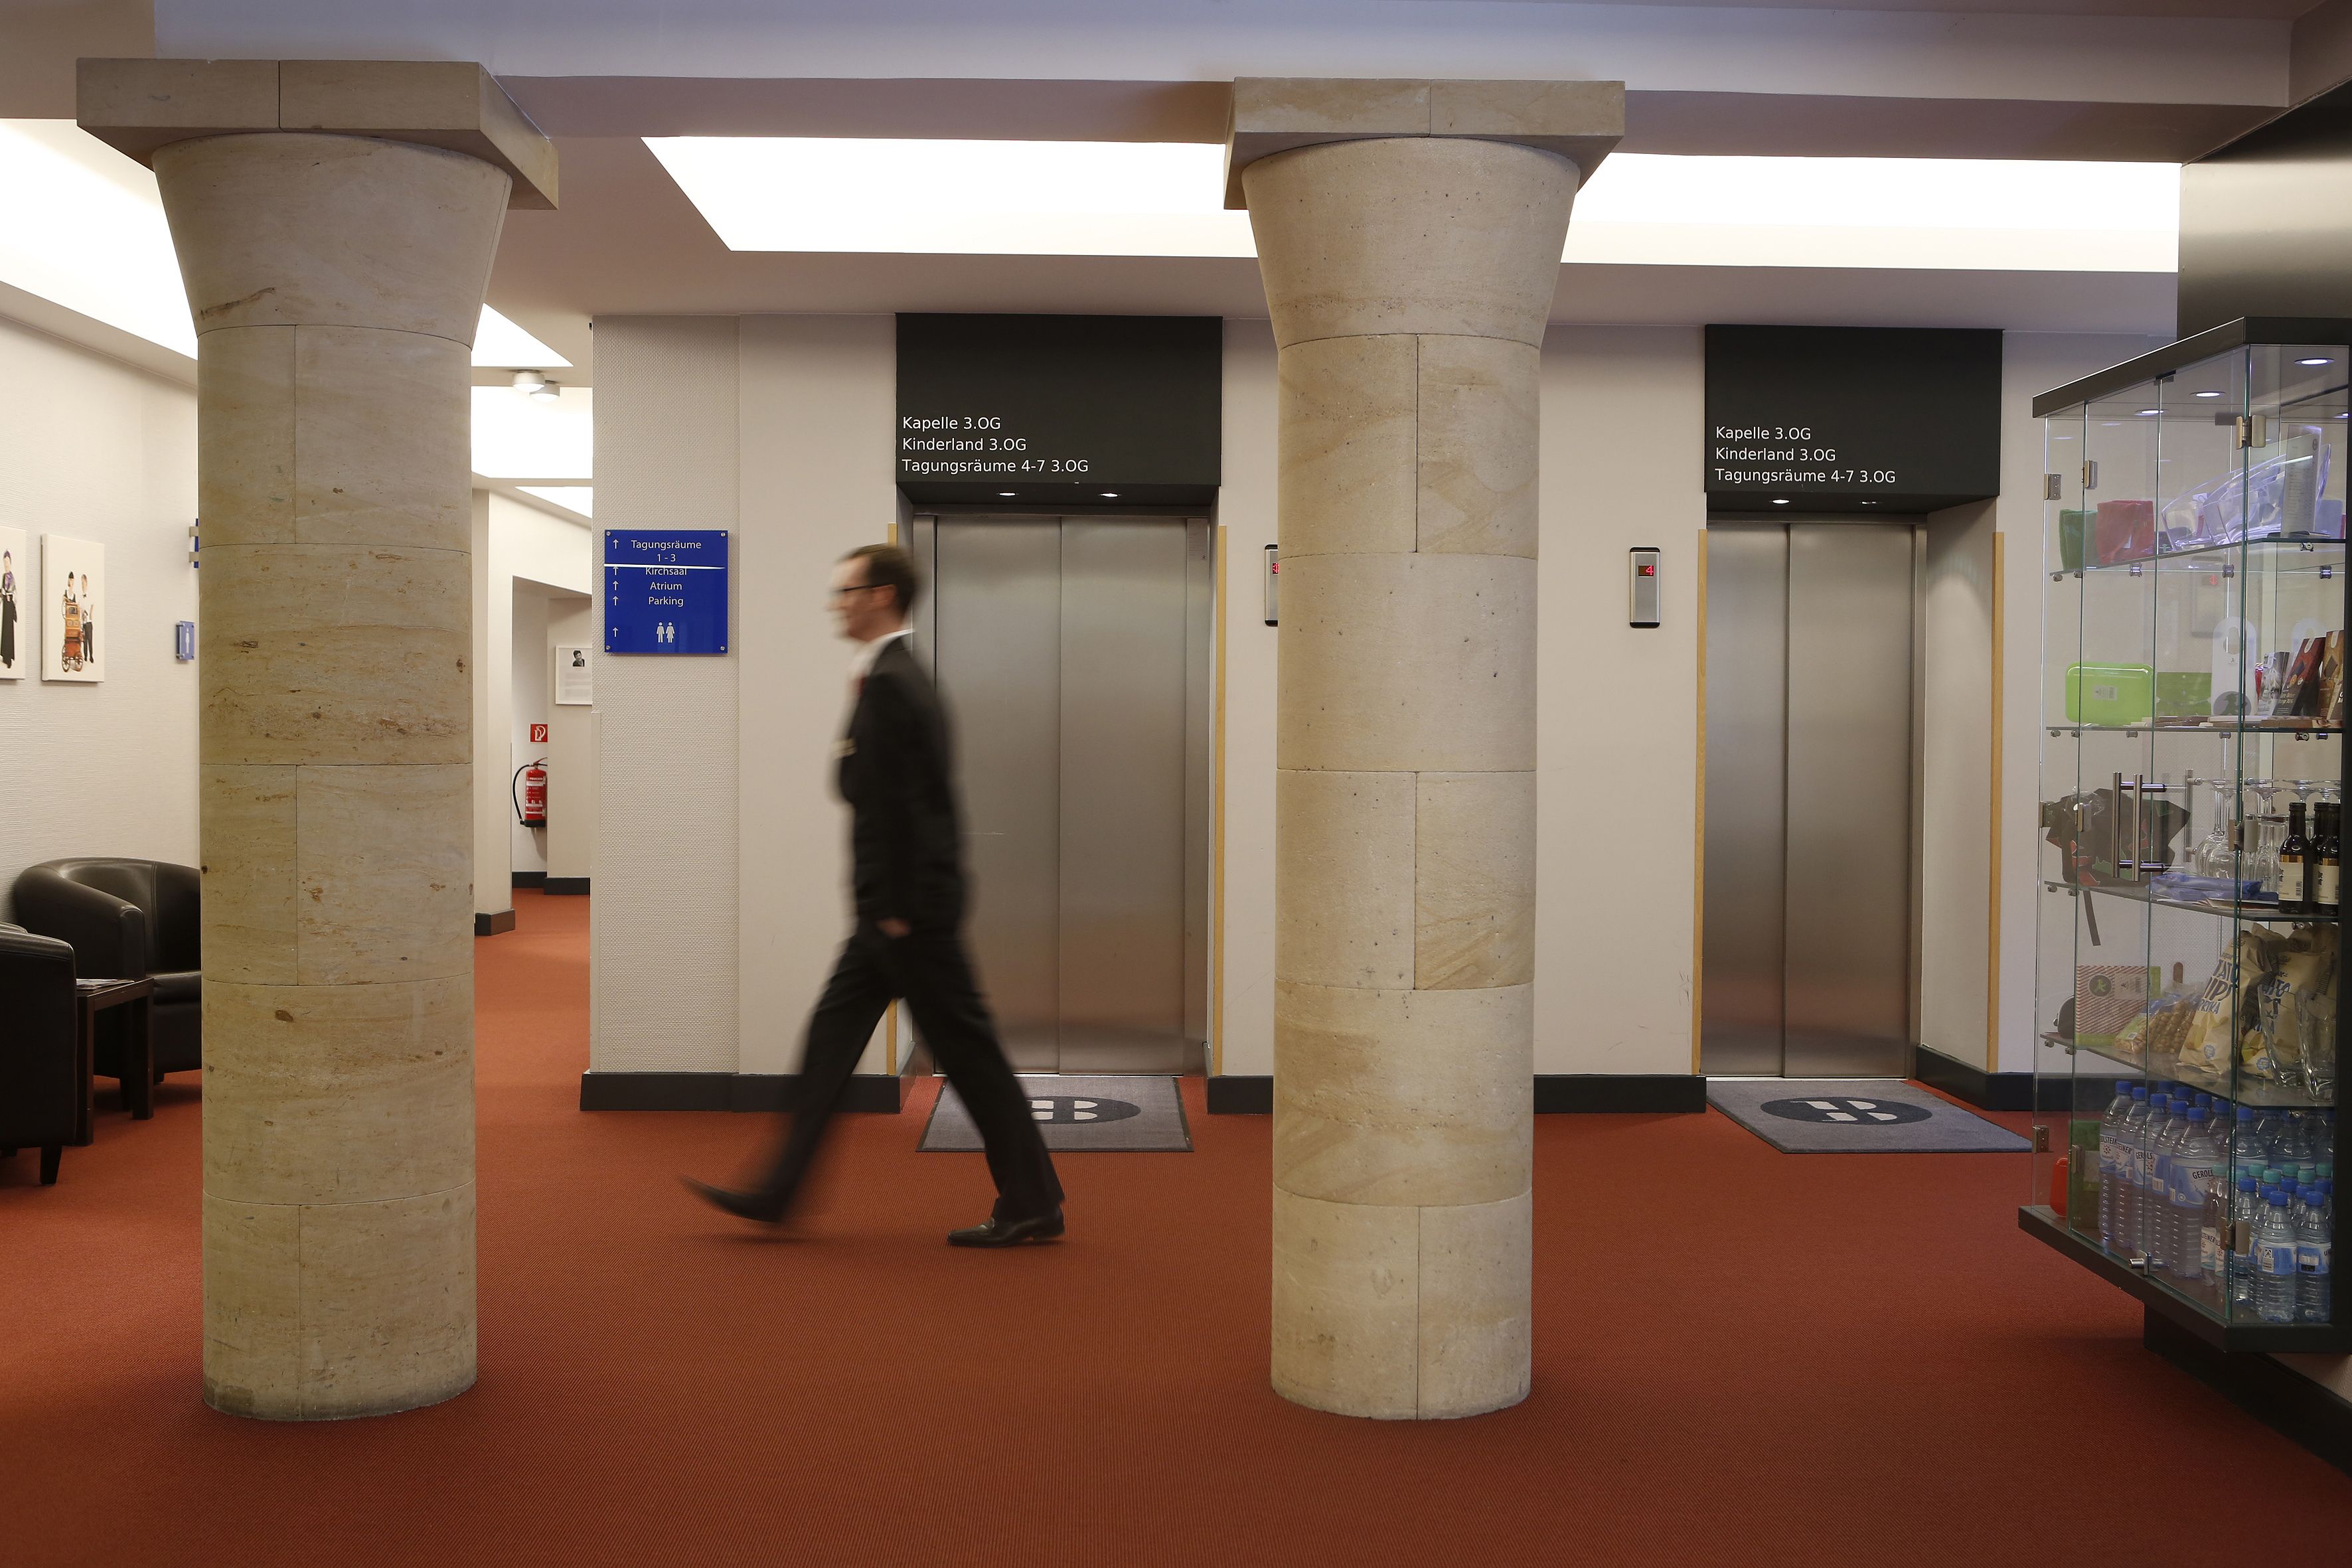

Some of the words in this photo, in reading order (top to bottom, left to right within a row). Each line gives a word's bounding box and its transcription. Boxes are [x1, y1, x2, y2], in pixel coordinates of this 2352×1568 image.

[903, 416, 958, 432] Kapelle
[963, 416, 1001, 430] 3.OG
[1716, 426, 1770, 442] Kapelle
[1774, 427, 1811, 440] 3.OG
[903, 437, 983, 451] Kinderland
[989, 438, 1026, 451] 3.OG
[1716, 447, 1794, 461] Kinderland
[1800, 448, 1836, 461] 3.OG
[901, 459, 1016, 475] Tagungsräume
[1021, 459, 1046, 472] 4-7
[1051, 459, 1089, 473] 3.OG
[1714, 468, 1826, 485] Tagungsräume
[1830, 469, 1854, 483] 4-7
[1859, 470, 1895, 483] 3.OG
[631, 540, 702, 551] Tagungsräume
[645, 567, 687, 576] Kirchsaal
[1646, 565, 1654, 576] 4
[649, 582, 682, 590] Atrium
[649, 595, 684, 607] Parking
